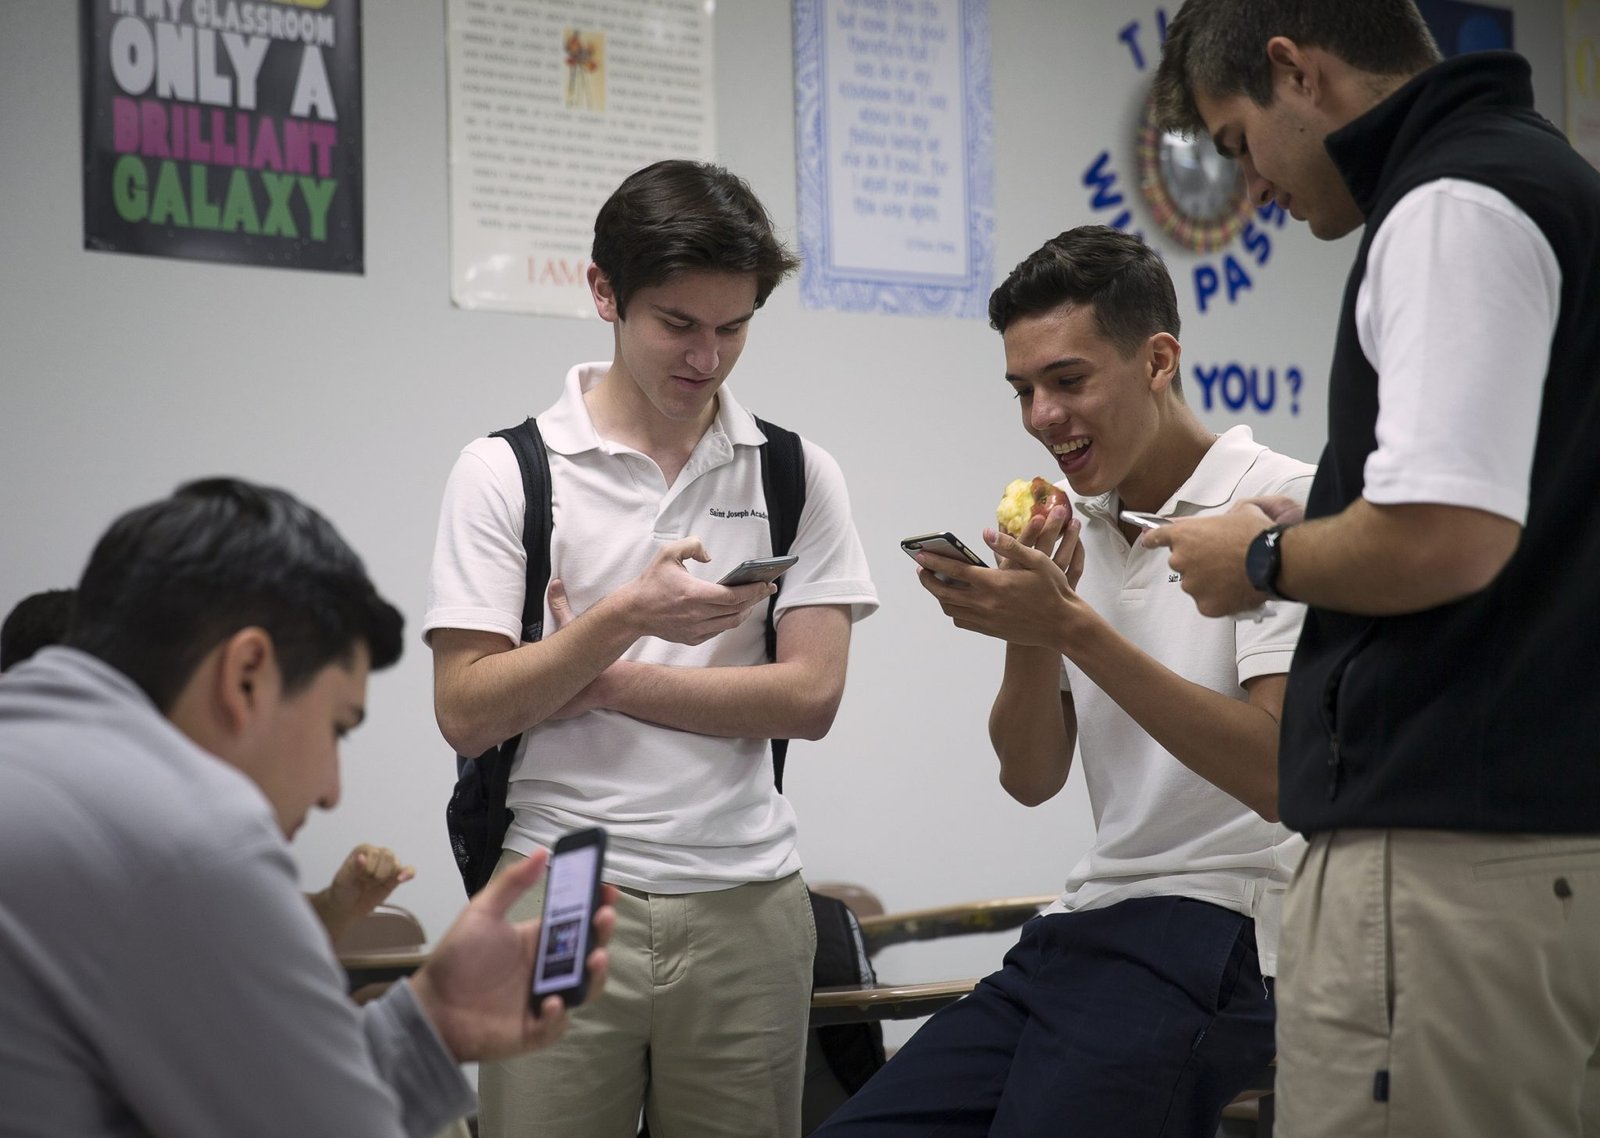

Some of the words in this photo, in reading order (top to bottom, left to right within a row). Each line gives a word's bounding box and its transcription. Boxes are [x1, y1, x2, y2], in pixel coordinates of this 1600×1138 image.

[145, 0, 183, 21] MY
[192, 1, 335, 48] CLASSROOM
[110, 16, 271, 110] ONLY
[290, 44, 338, 121] A
[113, 96, 338, 177] BRILLIANT
[112, 154, 338, 241] GALAXY
[709, 508, 725, 518] Saint
[726, 509, 749, 519] Joseph
